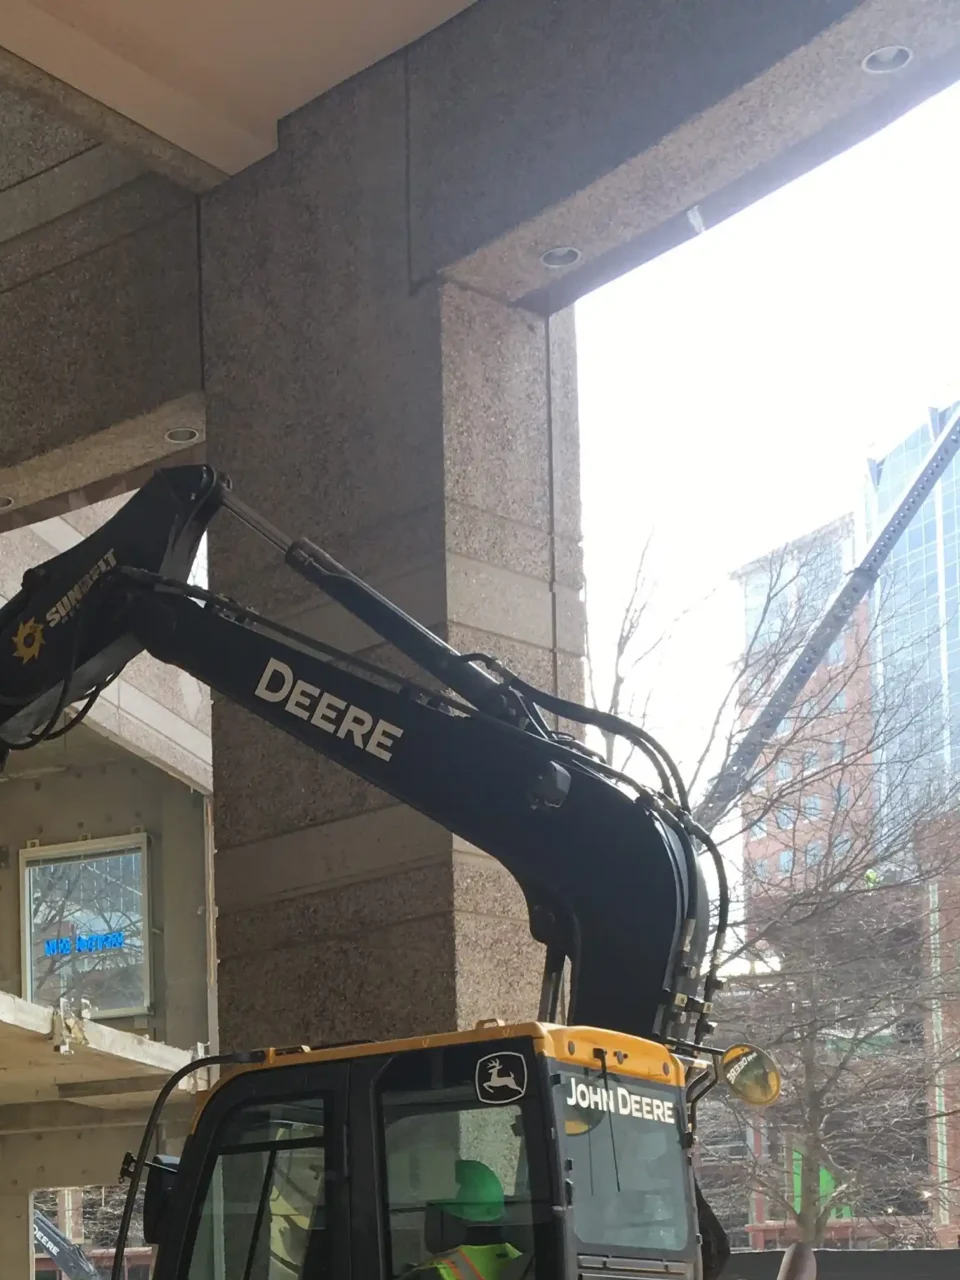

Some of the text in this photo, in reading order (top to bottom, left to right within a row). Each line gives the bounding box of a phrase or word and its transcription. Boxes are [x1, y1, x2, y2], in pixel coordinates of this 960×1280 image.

[253, 656, 404, 762] DEERE
[566, 1077, 676, 1124] JOHN DEERE
